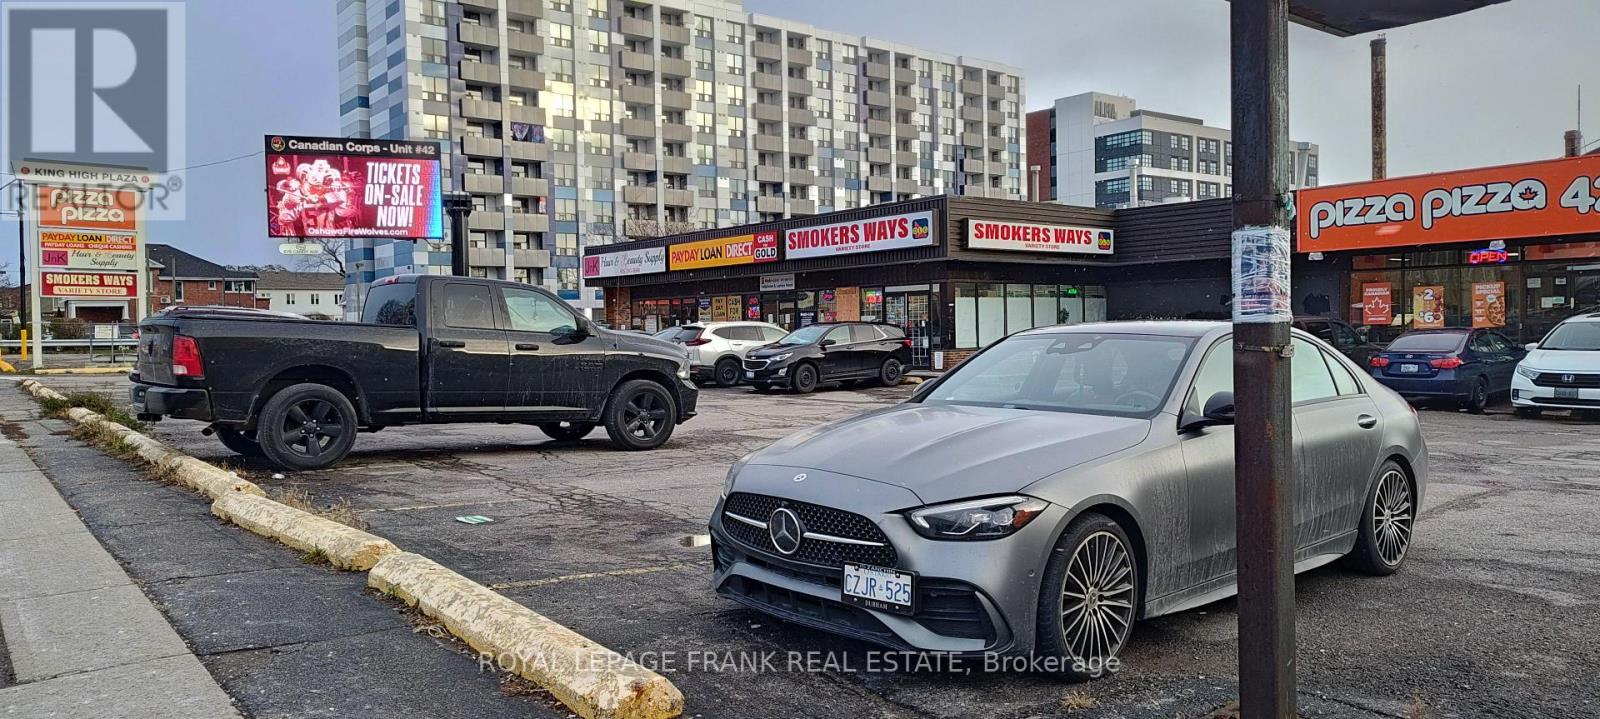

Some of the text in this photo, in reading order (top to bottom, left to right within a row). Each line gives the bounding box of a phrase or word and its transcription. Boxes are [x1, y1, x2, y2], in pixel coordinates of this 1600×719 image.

[288, 140, 344, 152] Canadian
[346, 142, 381, 154] Corps
[390, 143, 413, 154] Unit
[415, 145, 435, 155] #42
[34, 167, 138, 183] KING HIGH PLAZA
[366, 162, 421, 185] TICKETS
[364, 184, 424, 207] ON-SALE
[1309, 175, 1600, 239] pizza pizza 4
[61, 206, 125, 224] pizza
[376, 206, 413, 227] NOW!
[42, 233, 133, 244] PAYDAY LOAN DIRECT
[308, 227, 409, 236] OshawaFireWolves.com
[757, 234, 774, 243] CASH
[788, 224, 860, 250] SMOKERS
[863, 217, 909, 242] WAYS
[974, 222, 1092, 245] SMOKERS WAYS
[43, 251, 66, 263] JnK
[644, 249, 664, 265] Supply
[671, 242, 753, 263] PAYDAY LOAN DIRECT
[755, 247, 776, 258] GOLD
[1469, 251, 1507, 264] OPEN
[90, 257, 118, 267] Supply
[46, 273, 134, 286] SMOKERS WAYS
[1423, 288, 1435, 301] 2
